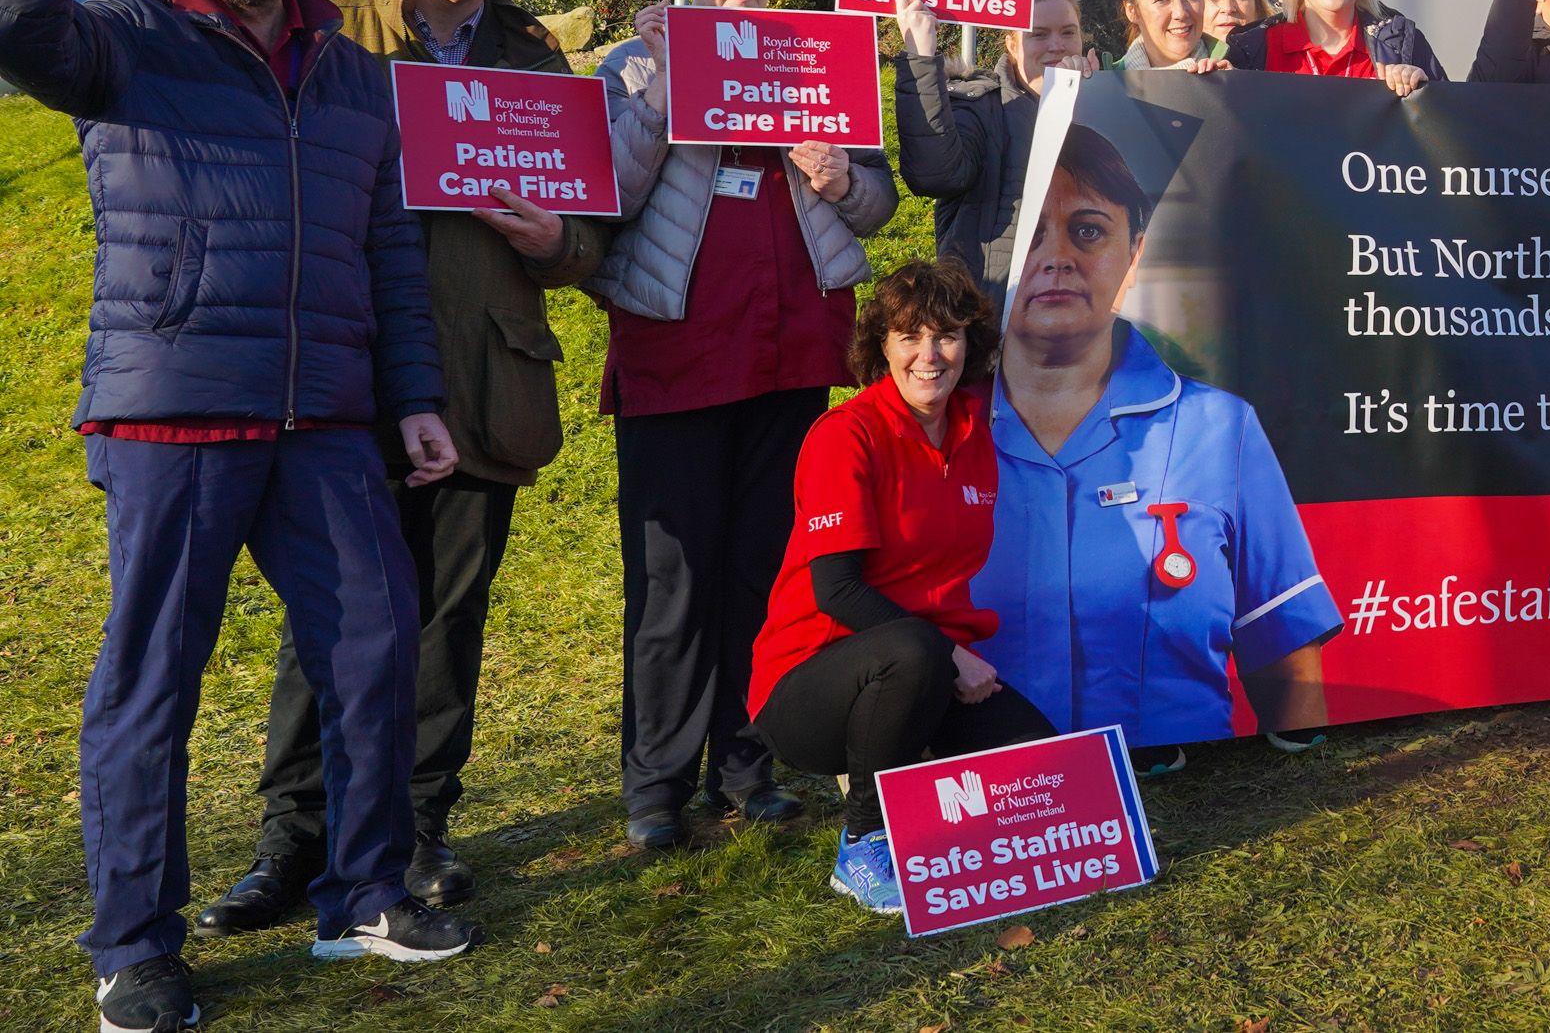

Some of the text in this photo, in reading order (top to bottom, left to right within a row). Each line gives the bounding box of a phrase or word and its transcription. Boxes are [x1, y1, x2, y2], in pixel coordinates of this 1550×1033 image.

[723, 80, 830, 104] Patient
[704, 108, 850, 133] Care First
[456, 143, 565, 170] Patient
[439, 172, 587, 200] Care First
[1342, 152, 1427, 195] One
[1348, 234, 1421, 278] But
[1424, 389, 1525, 433] time
[808, 512, 843, 532] STAFF
[990, 772, 1064, 797] Royal College
[993, 791, 1052, 812] of Nursing
[997, 804, 1065, 826] Northern Ireland
[906, 819, 1121, 882] Safe Staffing
[926, 854, 1119, 914] Saves Lives
